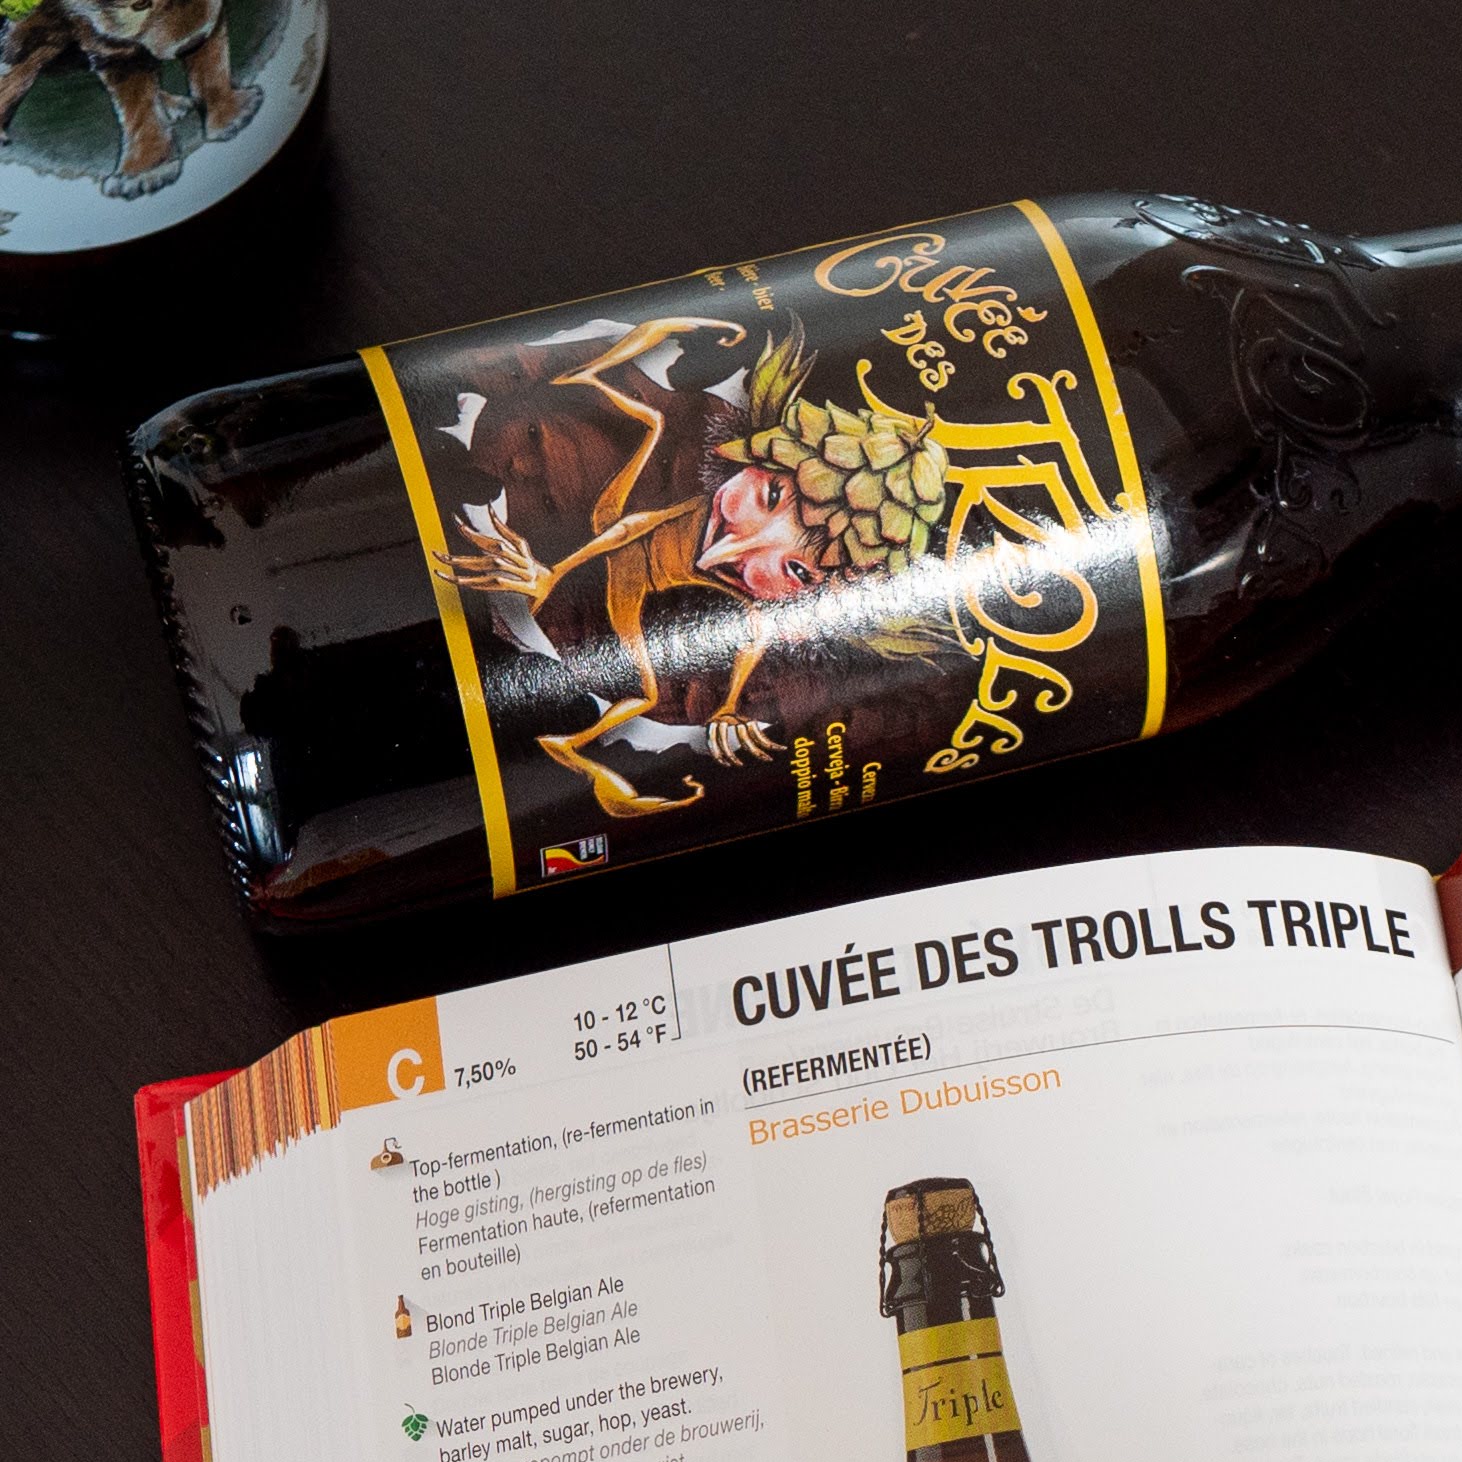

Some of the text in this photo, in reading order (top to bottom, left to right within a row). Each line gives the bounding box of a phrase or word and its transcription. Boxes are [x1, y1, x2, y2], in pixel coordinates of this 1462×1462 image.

[790, 737, 817, 789] doppio
[824, 722, 850, 779] Cerveja
[732, 899, 1416, 1027] CUVÉE DES TROLLS TRIPLE
[574, 1010, 595, 1031] 10
[616, 1001, 638, 1022] 12
[643, 995, 666, 1016] °C
[575, 1039, 598, 1061] 50
[618, 1030, 641, 1051] 54
[646, 1023, 667, 1045] °F
[742, 1032, 933, 1096] (REFERMENTÉE)
[387, 1048, 426, 1101] C
[453, 1058, 518, 1090] 7,50%
[749, 1066, 1062, 1147] Brasserie Dubuisson
[410, 1099, 714, 1178] Top-fermentation, (re-fermentation in
[413, 1186, 438, 1203] the
[444, 1173, 491, 1196] bottle
[418, 1180, 715, 1255] Fermentation haute, (refermentation
[421, 1244, 521, 1280] en bouteille)
[426, 1277, 624, 1333] Blond Triple Belgian Ale
[437, 1367, 723, 1438] Water pumped under the brewery,
[496, 1431, 537, 1453] malt,
[543, 1422, 593, 1444] sugar,
[599, 1413, 636, 1432] hop,
[641, 1398, 691, 1427] yeast.
[913, 1376, 1005, 1427] Triple
